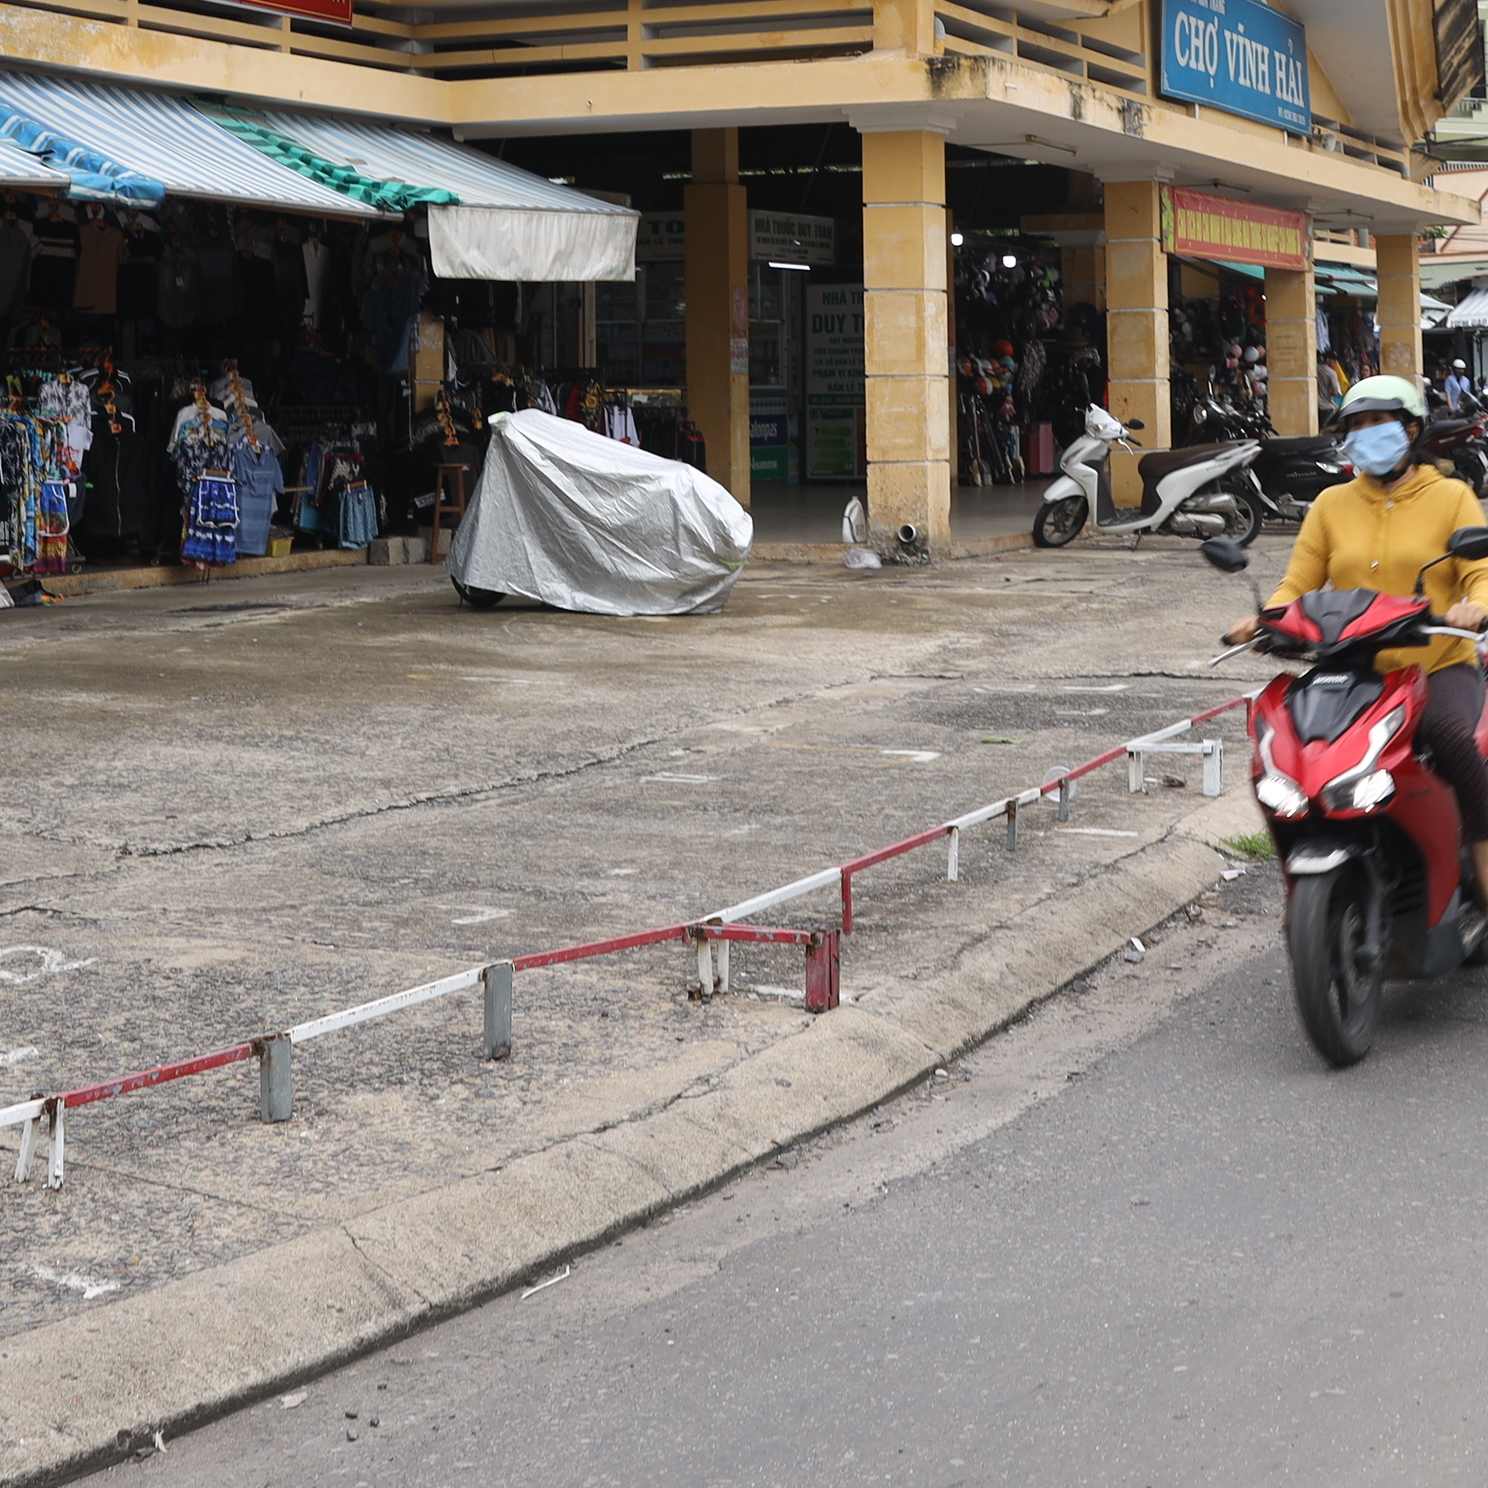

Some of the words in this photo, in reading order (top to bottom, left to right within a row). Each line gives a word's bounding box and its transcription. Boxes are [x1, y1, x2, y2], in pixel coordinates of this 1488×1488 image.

[1174, 11, 1218, 89] CHỢ
[1224, 22, 1271, 95] VĨNH
[1274, 38, 1305, 108] HẢI
[822, 288, 847, 305] NHÀ
[812, 314, 846, 333] DUY
